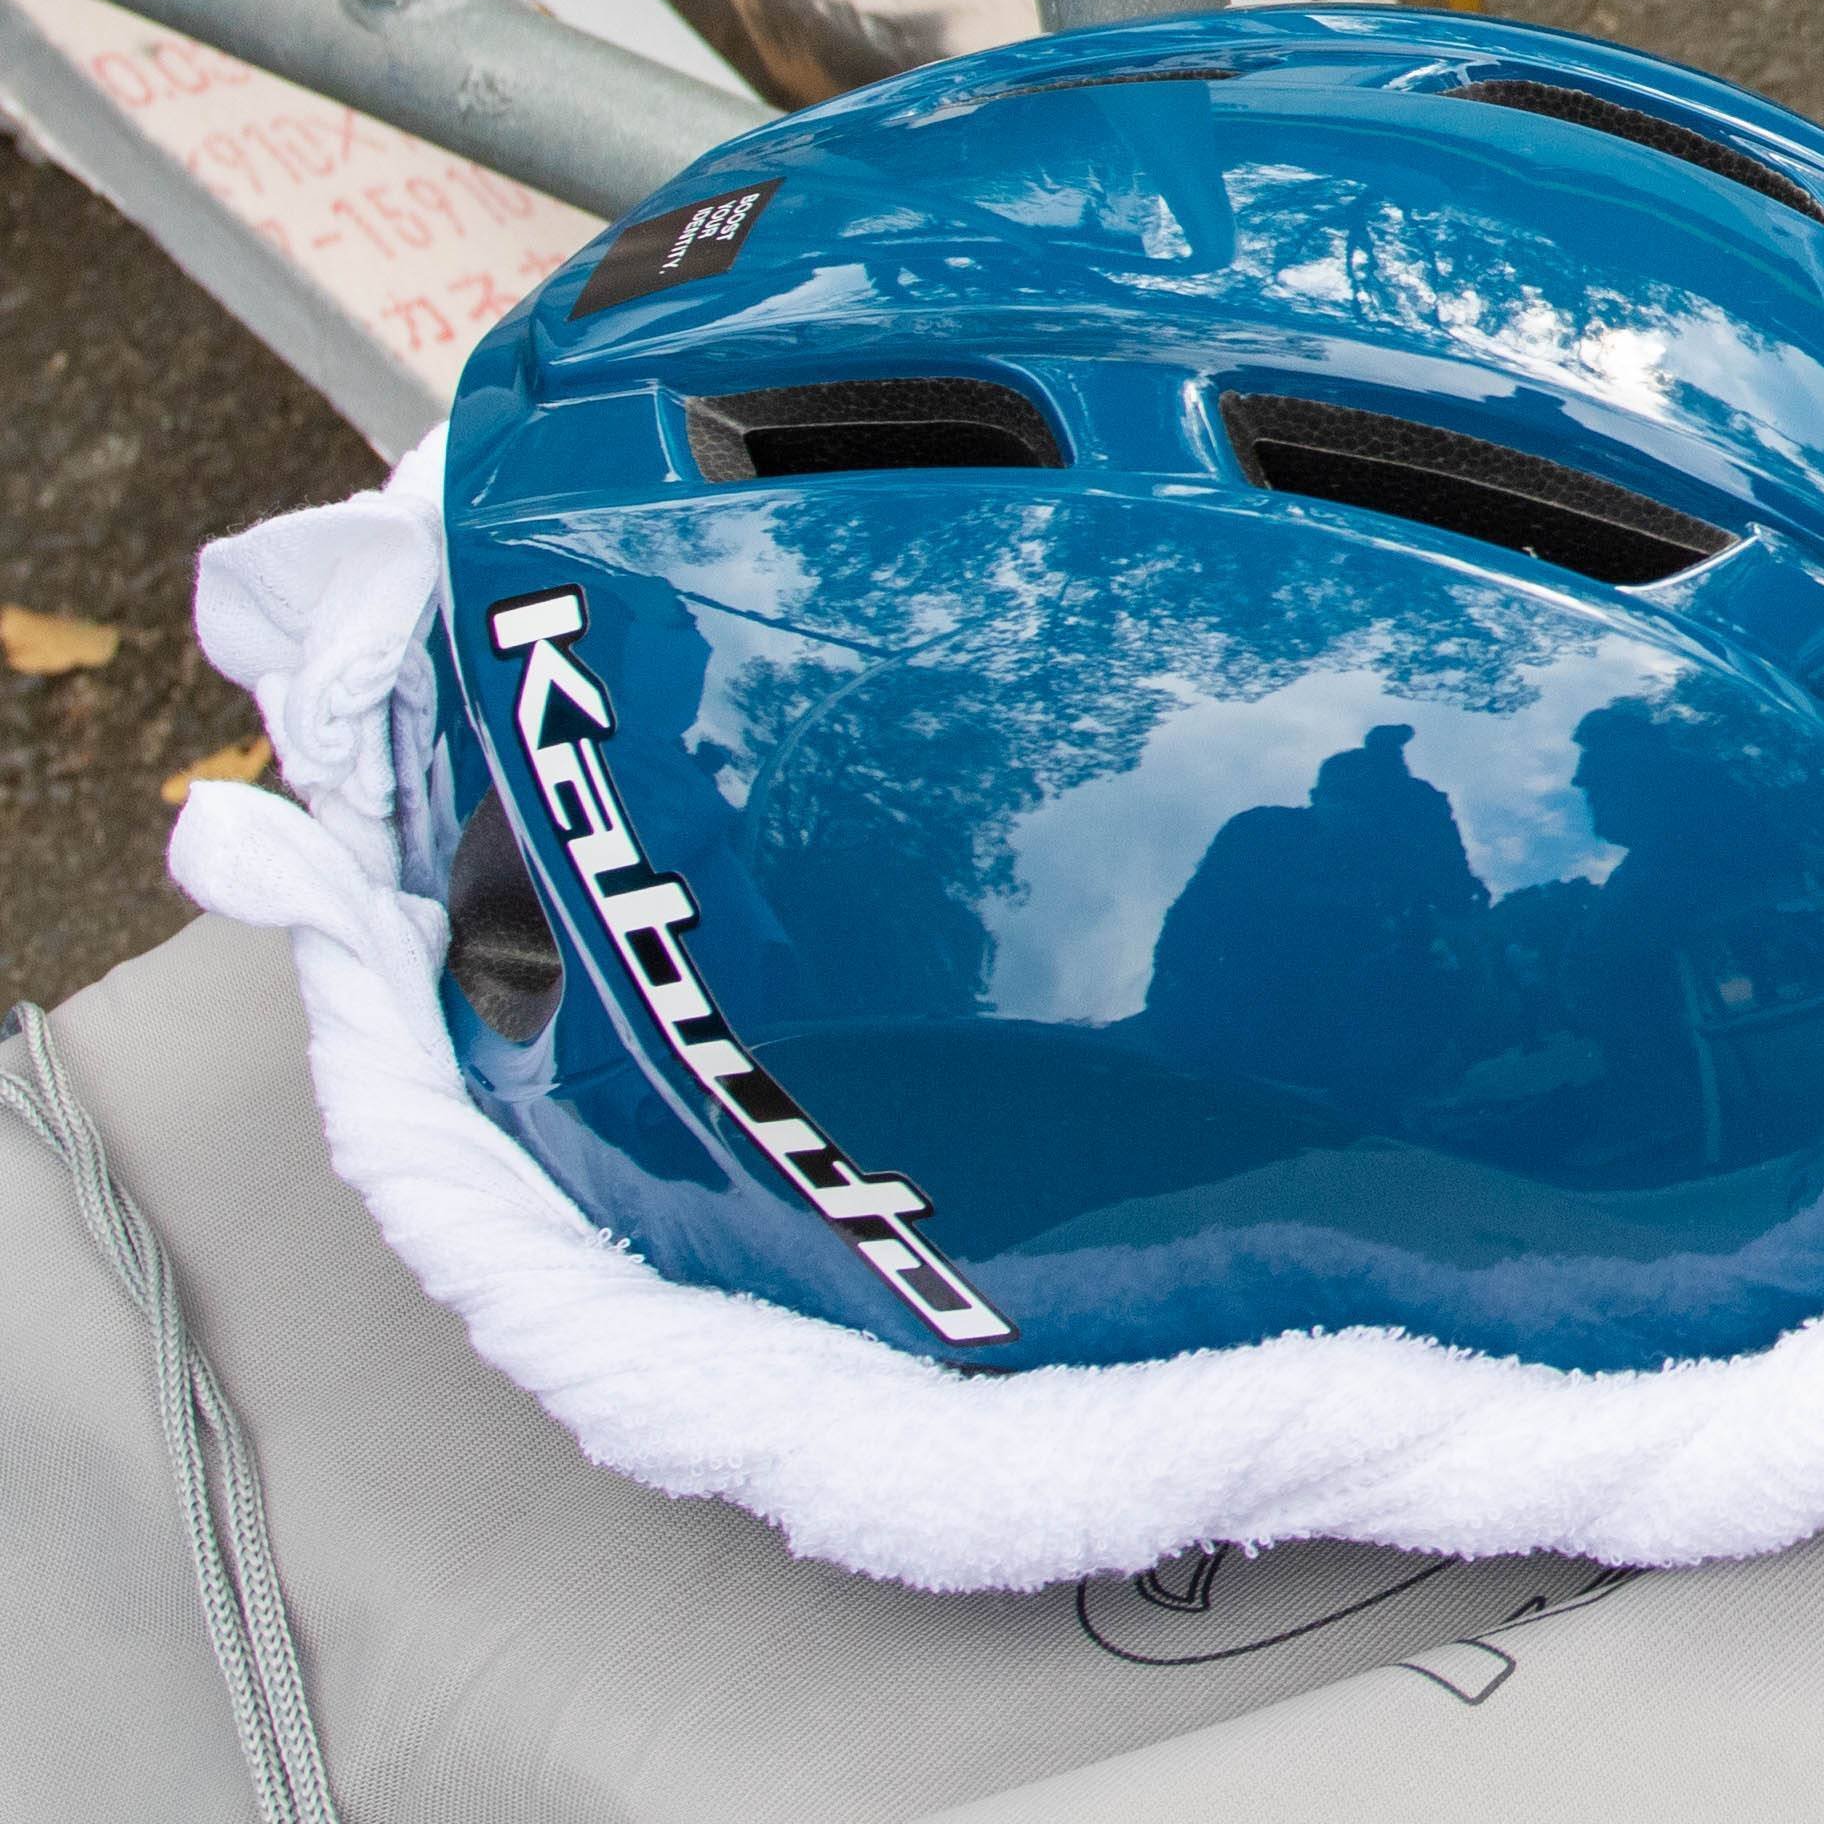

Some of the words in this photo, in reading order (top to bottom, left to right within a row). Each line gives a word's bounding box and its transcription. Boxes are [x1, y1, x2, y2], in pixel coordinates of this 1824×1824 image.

[658, 206, 716, 275] IDENTITY.
[697, 199, 737, 239] YOUR
[716, 192, 760, 241] BOOST
[489, 590, 1015, 1344] Kabuto
